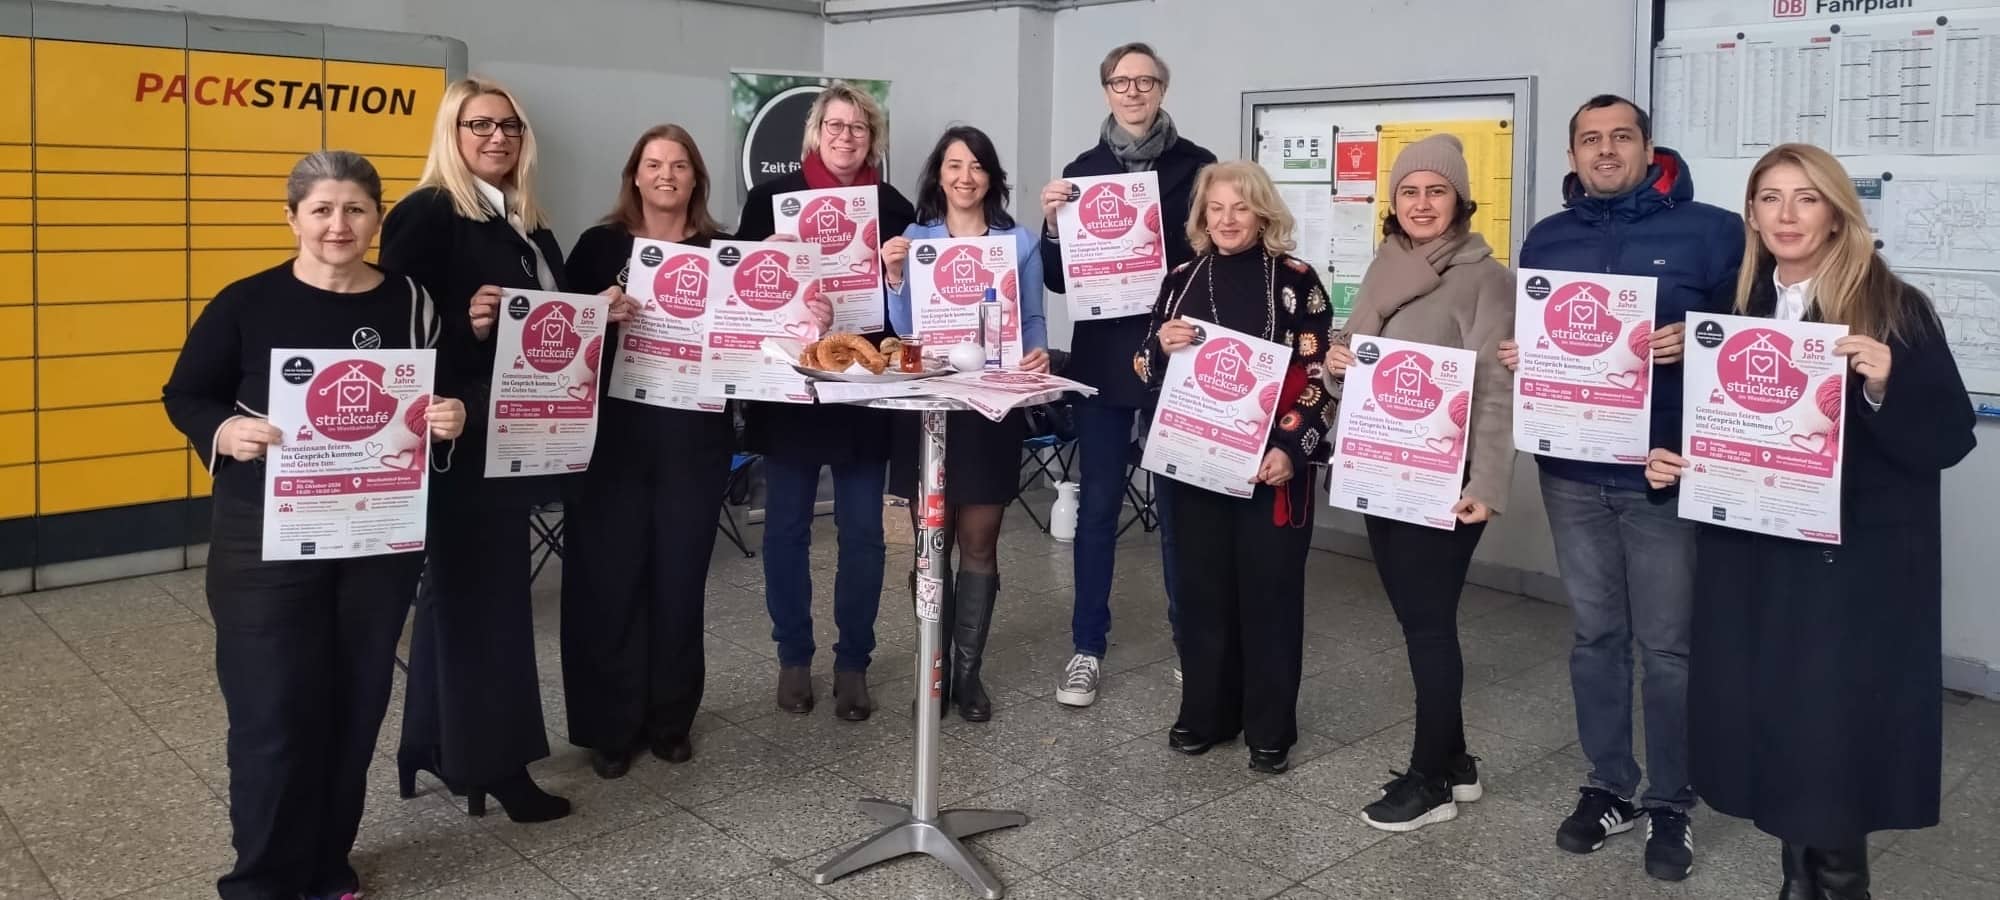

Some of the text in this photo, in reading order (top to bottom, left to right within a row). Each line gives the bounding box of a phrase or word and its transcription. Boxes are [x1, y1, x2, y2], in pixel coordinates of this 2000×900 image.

[1777, 0, 1802, 14] DB
[135, 72, 416, 116] PACKSTATION
[761, 161, 801, 173] Zeit fü
[852, 197, 865, 207] 65
[1086, 218, 1133, 230] strickcafé
[989, 247, 1004, 257] 65
[658, 293, 706, 308] strickcaf
[740, 288, 792, 300] strickcafé
[1619, 290, 1637, 302] 65
[582, 308, 595, 319] 65
[1551, 328, 1613, 343] strickcafé
[1804, 338, 1825, 353] 65
[527, 347, 575, 359] strickcafé
[1259, 352, 1274, 365] 65
[1802, 351, 1825, 361] Jahre
[395, 364, 415, 377] 65
[1441, 360, 1458, 373] 65
[394, 377, 415, 385] Jahre
[1198, 372, 1248, 395] strickcafé
[1726, 381, 1799, 400] strickcafé
[1377, 393, 1436, 410] strickcafé
[315, 411, 390, 426] strickcafé
